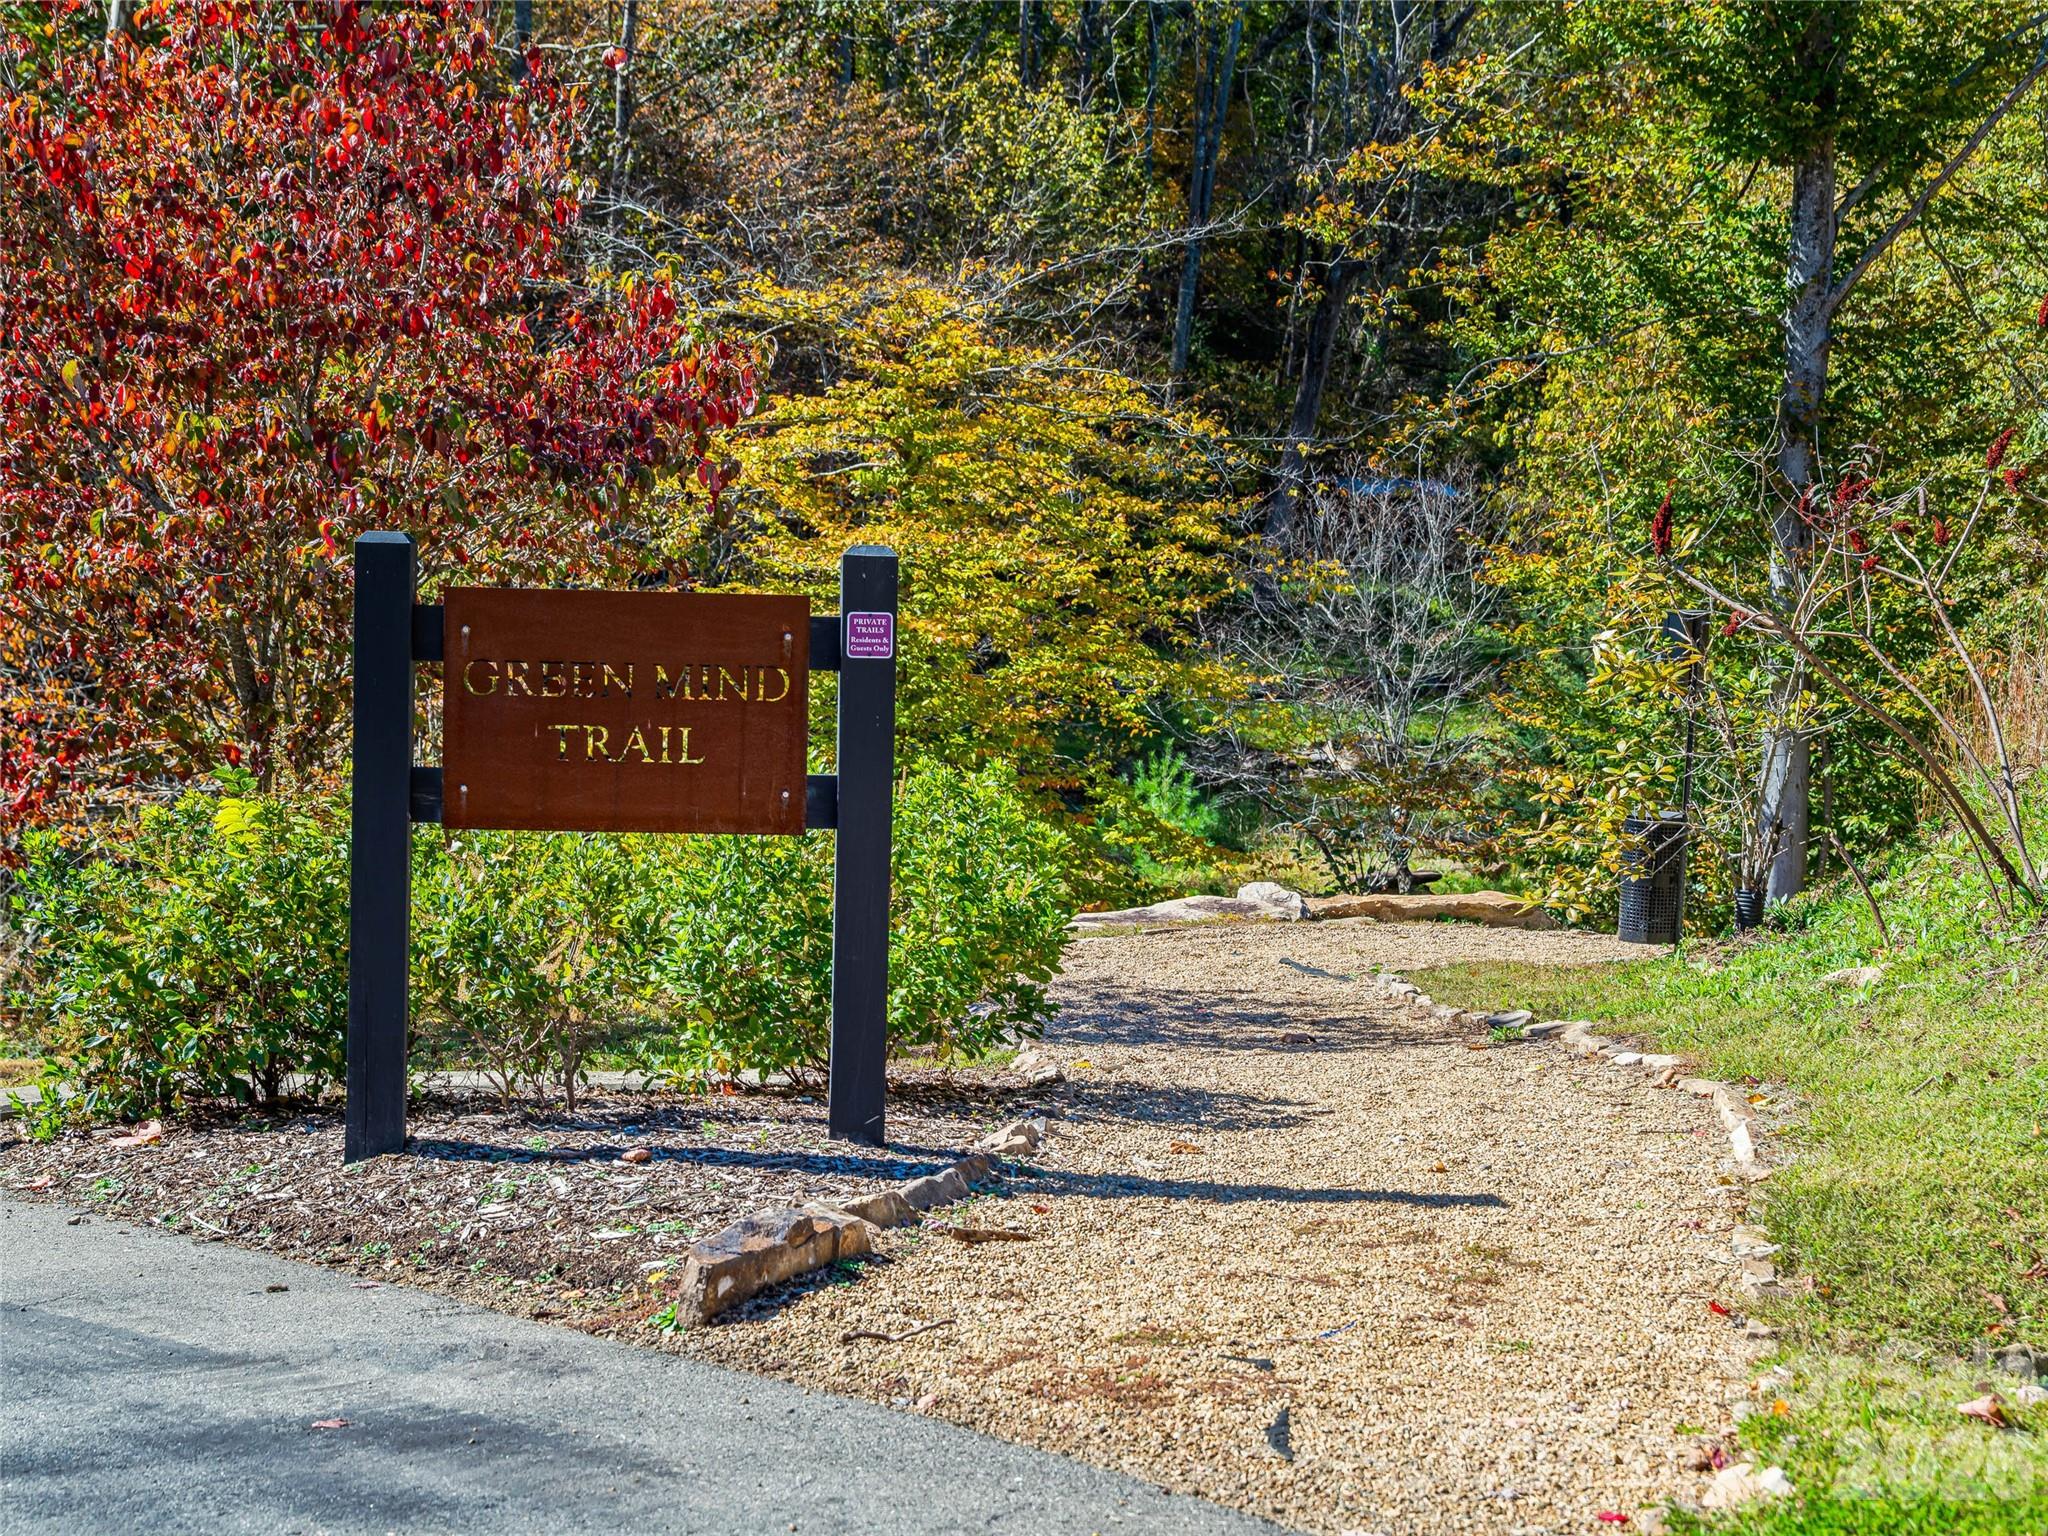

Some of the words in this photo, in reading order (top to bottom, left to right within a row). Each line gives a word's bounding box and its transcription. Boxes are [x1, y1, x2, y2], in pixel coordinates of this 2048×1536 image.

[853, 618, 887, 626] PRIVATE
[856, 626, 885, 634] TRAILS
[850, 644, 873, 652] Guests
[873, 645, 890, 654] Only
[463, 659, 635, 698] GREEN
[655, 663, 792, 703] MIND
[547, 724, 707, 765] TRAIL
